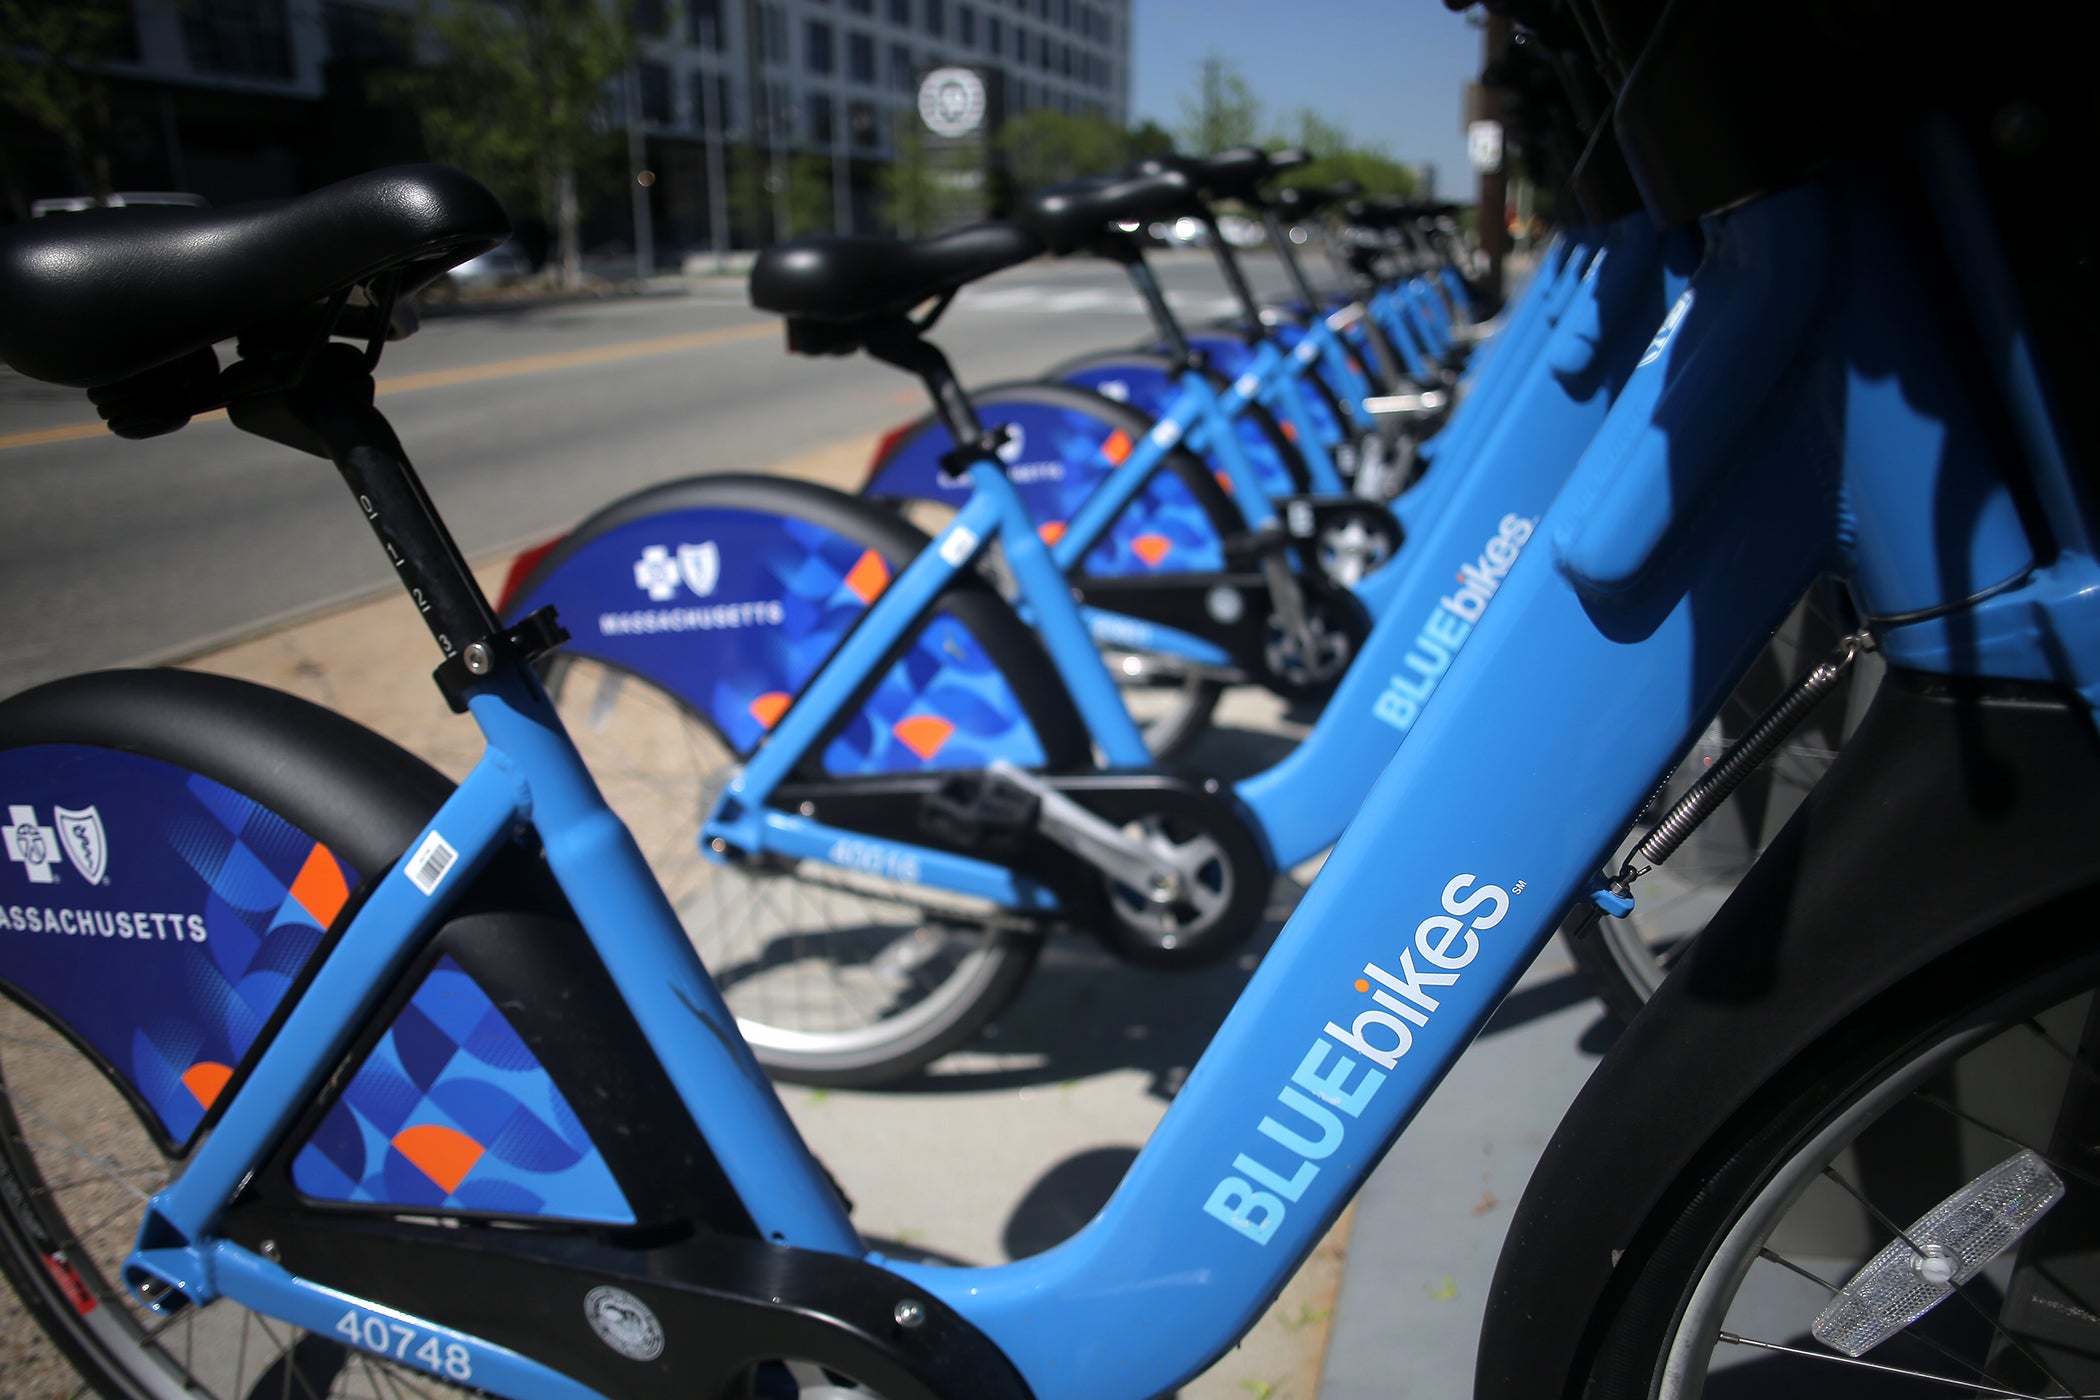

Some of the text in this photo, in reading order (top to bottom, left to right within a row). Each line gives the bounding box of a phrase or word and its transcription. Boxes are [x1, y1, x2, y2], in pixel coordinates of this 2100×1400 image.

[1372, 512, 1534, 731] BLUEbikes
[1202, 873, 1527, 1246] BLUEbikes SM
[335, 1310, 472, 1380] 40748
